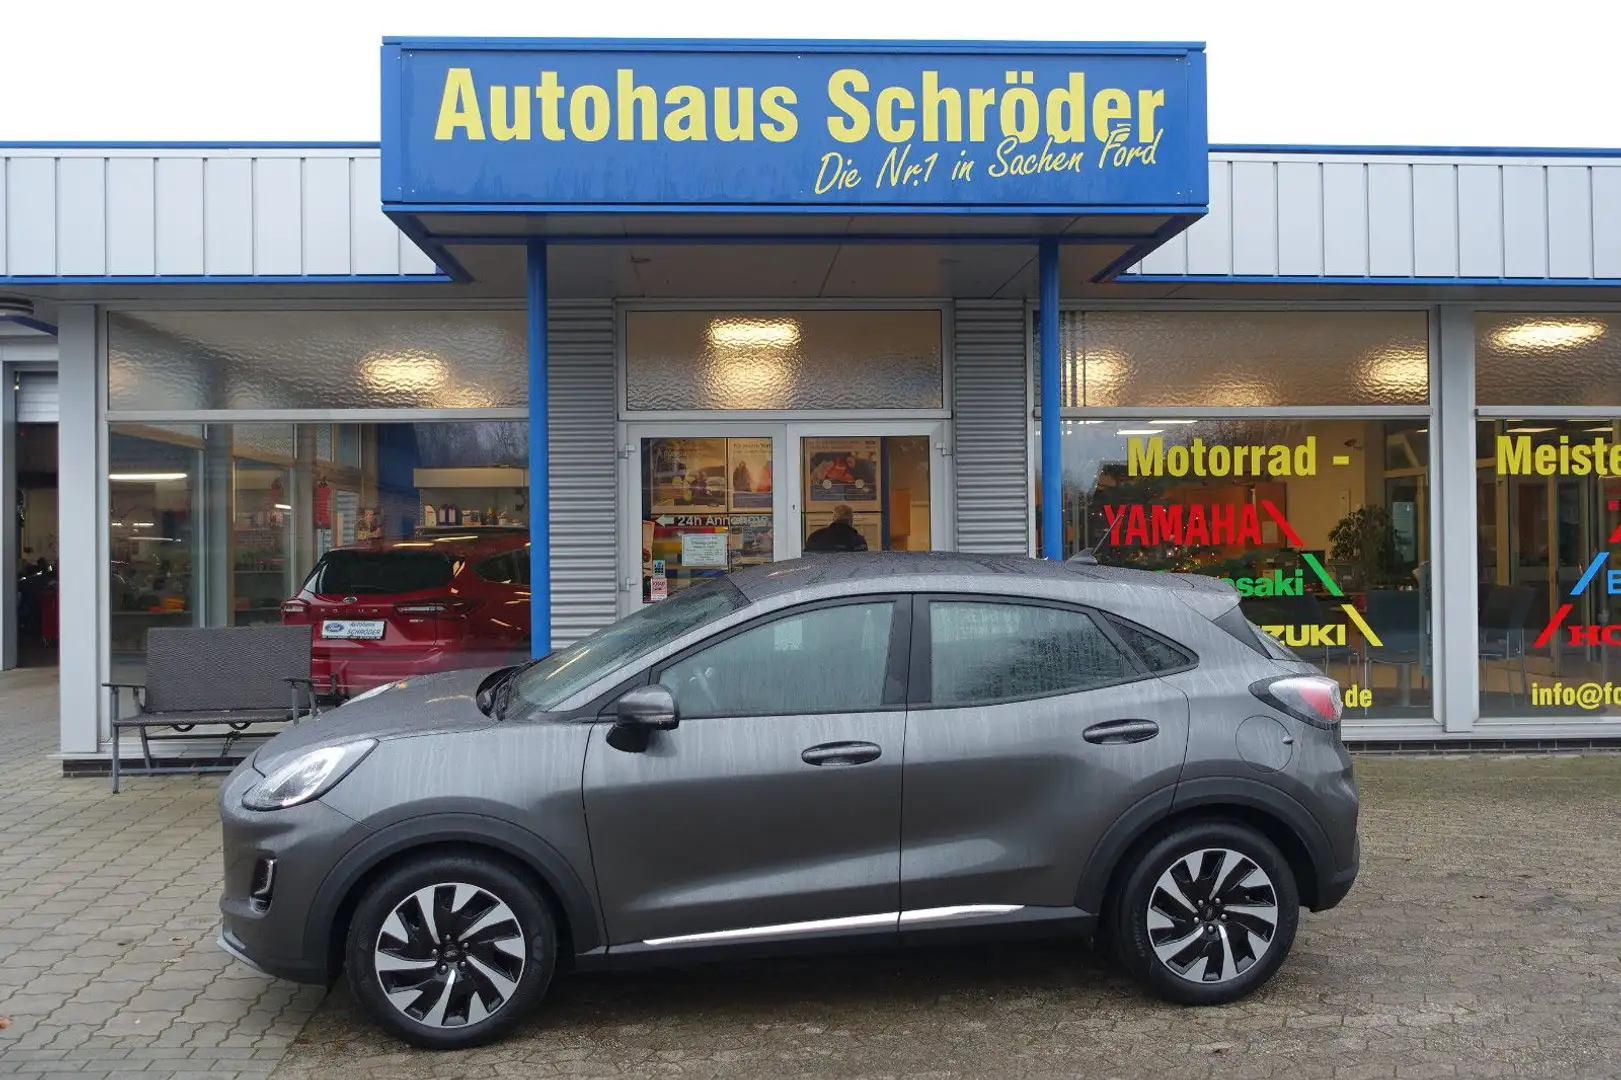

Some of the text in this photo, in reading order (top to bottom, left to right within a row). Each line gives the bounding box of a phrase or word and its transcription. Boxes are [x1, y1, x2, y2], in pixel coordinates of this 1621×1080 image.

[434, 67, 1165, 144] Autohaus Schröder
[814, 124, 1164, 195] Die Nr.1 in Sachen Ford
[1127, 435, 1317, 477] Motorrad
[1103, 503, 1263, 547] YAMAHA
[1222, 568, 1304, 597] saki
[1259, 624, 1346, 647] ZUKI
